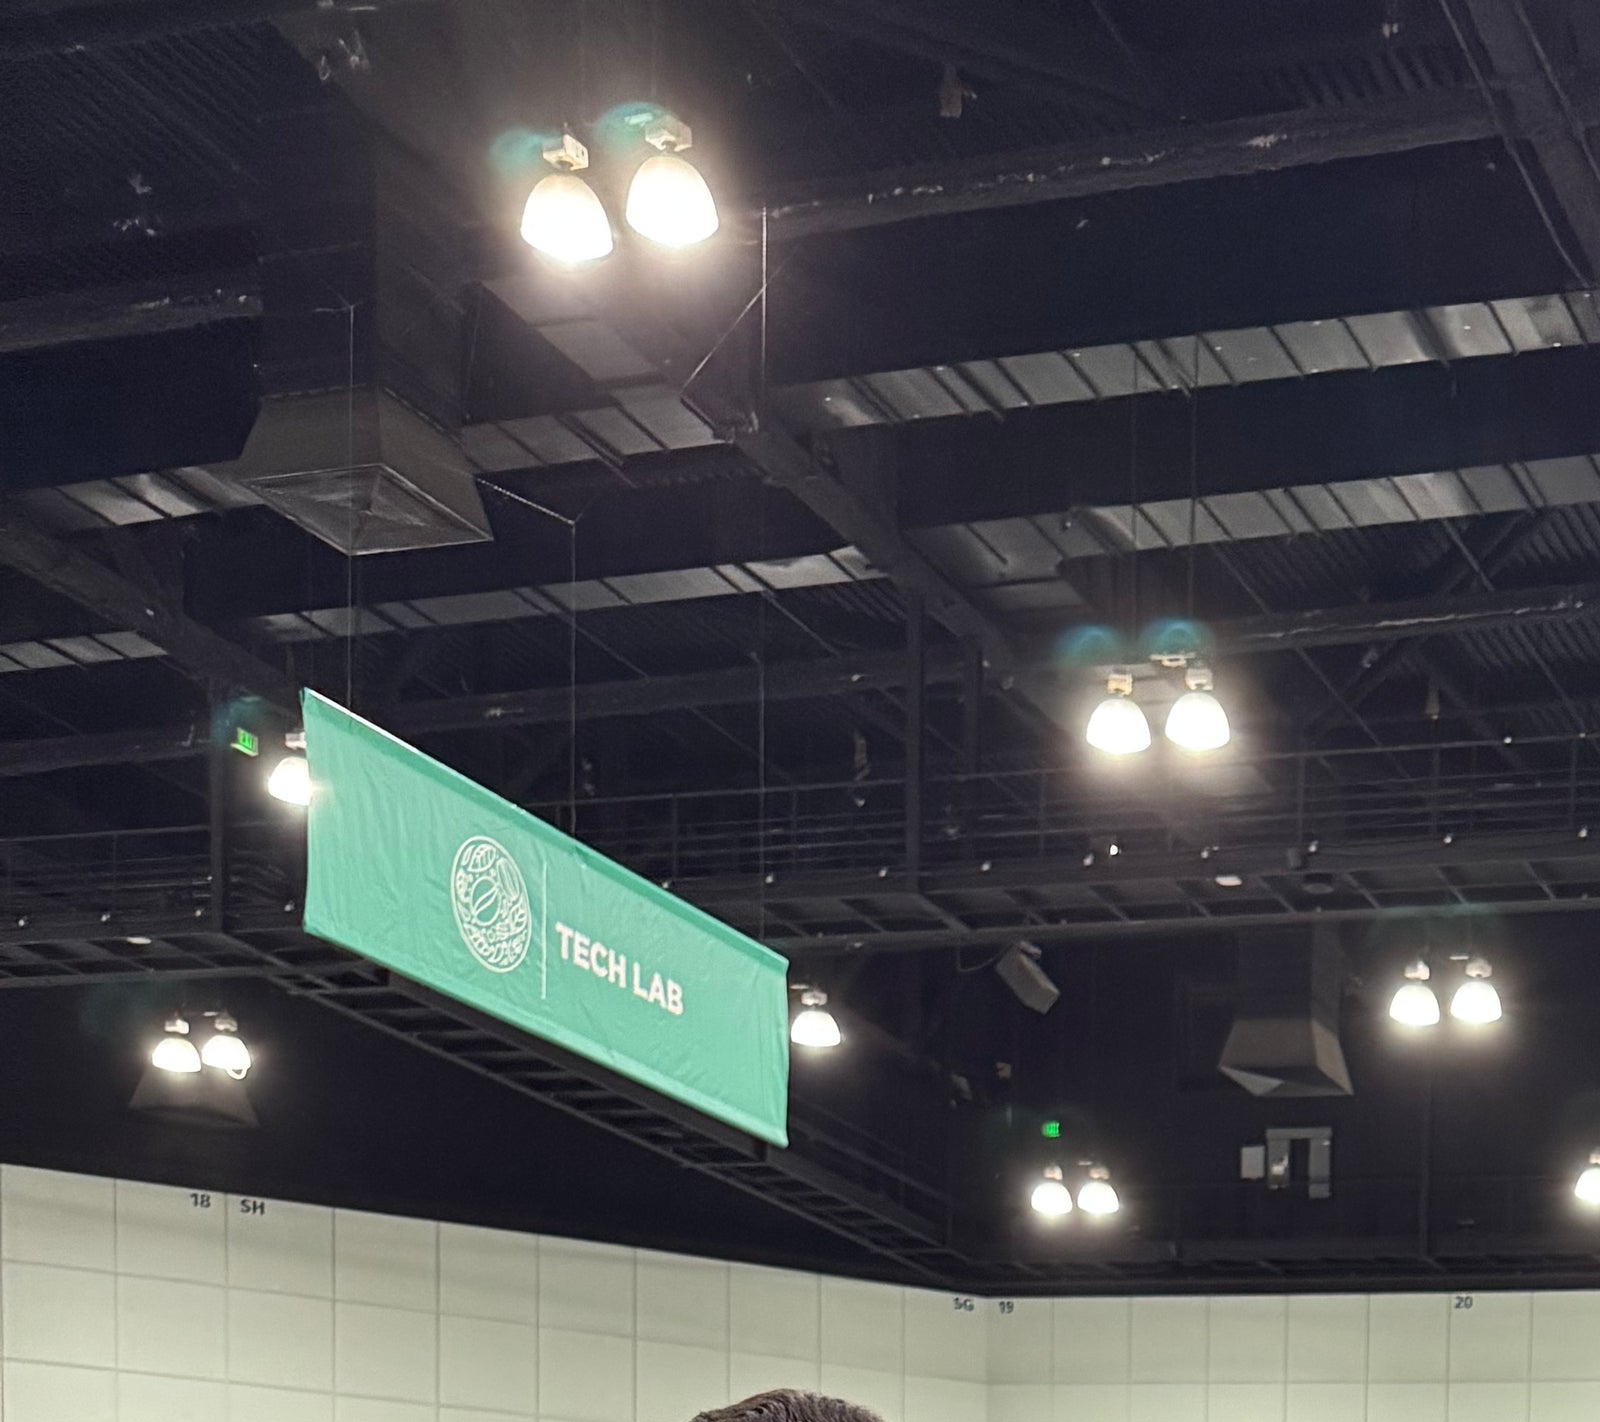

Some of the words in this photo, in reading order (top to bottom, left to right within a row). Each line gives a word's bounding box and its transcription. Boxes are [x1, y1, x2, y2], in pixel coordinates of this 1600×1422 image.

[555, 921, 627, 989] TECH
[632, 961, 684, 1016] LAB
[240, 1199, 265, 1215] SH
[1454, 1295, 1473, 1309] 20
